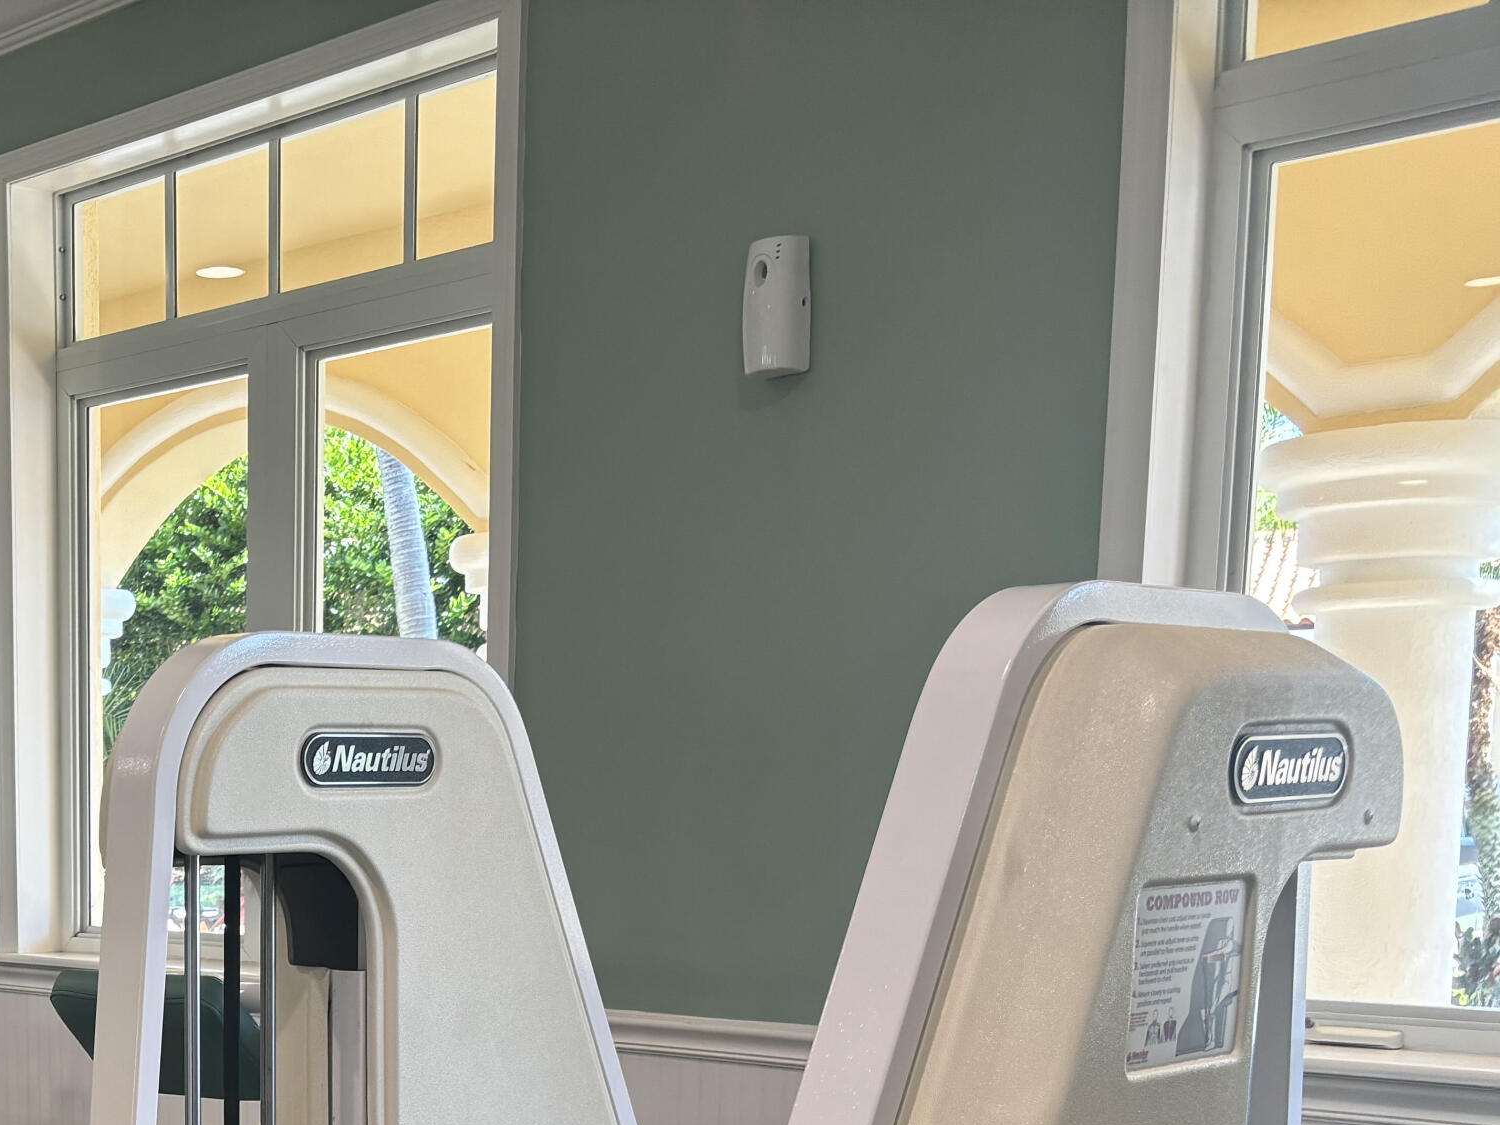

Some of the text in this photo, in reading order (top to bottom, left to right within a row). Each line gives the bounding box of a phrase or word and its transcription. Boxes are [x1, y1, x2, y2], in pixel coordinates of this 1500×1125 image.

[331, 744, 429, 773] Nautilus
[1257, 747, 1343, 787] Nautilus
[1146, 888, 1240, 911] COMPOUND ROW
